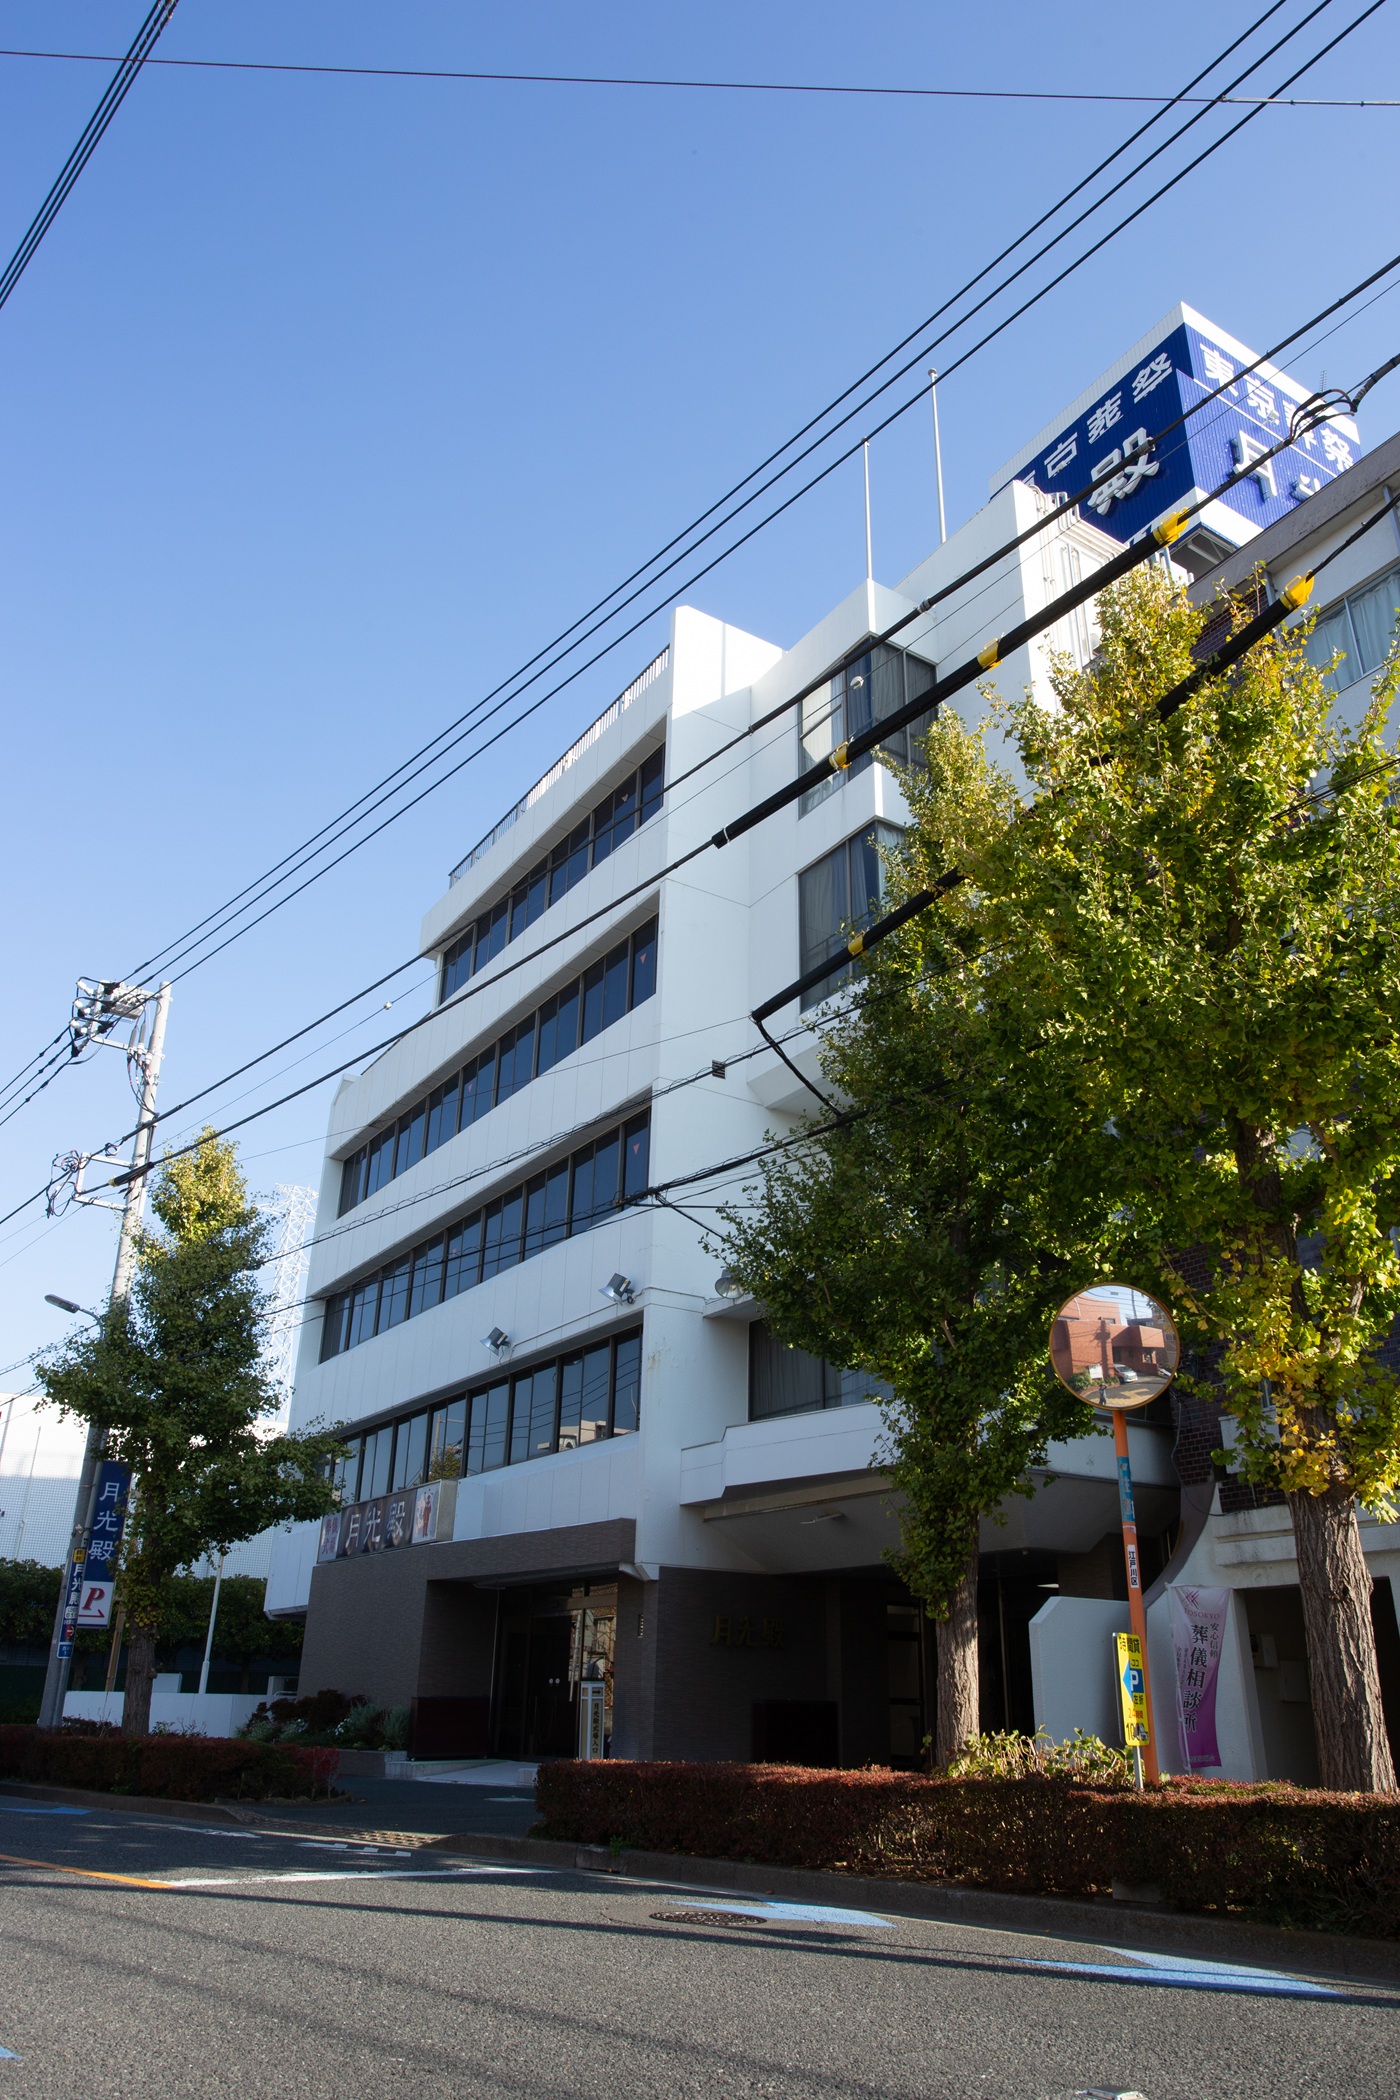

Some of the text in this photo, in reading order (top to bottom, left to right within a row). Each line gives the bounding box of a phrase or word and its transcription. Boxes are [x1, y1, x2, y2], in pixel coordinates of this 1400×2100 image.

[88, 1481, 120, 1561] 月光殿
[345, 1501, 405, 1549] 月光殿
[1128, 1551, 1138, 1586] 江戸川区
[82, 1587, 105, 1611] P
[1184, 1607, 1220, 1620] TOSOKYO
[709, 1615, 785, 1648] 月光殿
[1119, 1636, 1140, 1654] 時間貸
[1210, 1622, 1219, 1658] 安心信頼
[1130, 1670, 1139, 1692] P
[1183, 1624, 1209, 1732] 葬儀相談所
[592, 1702, 600, 1753] 月光殿式場入口
